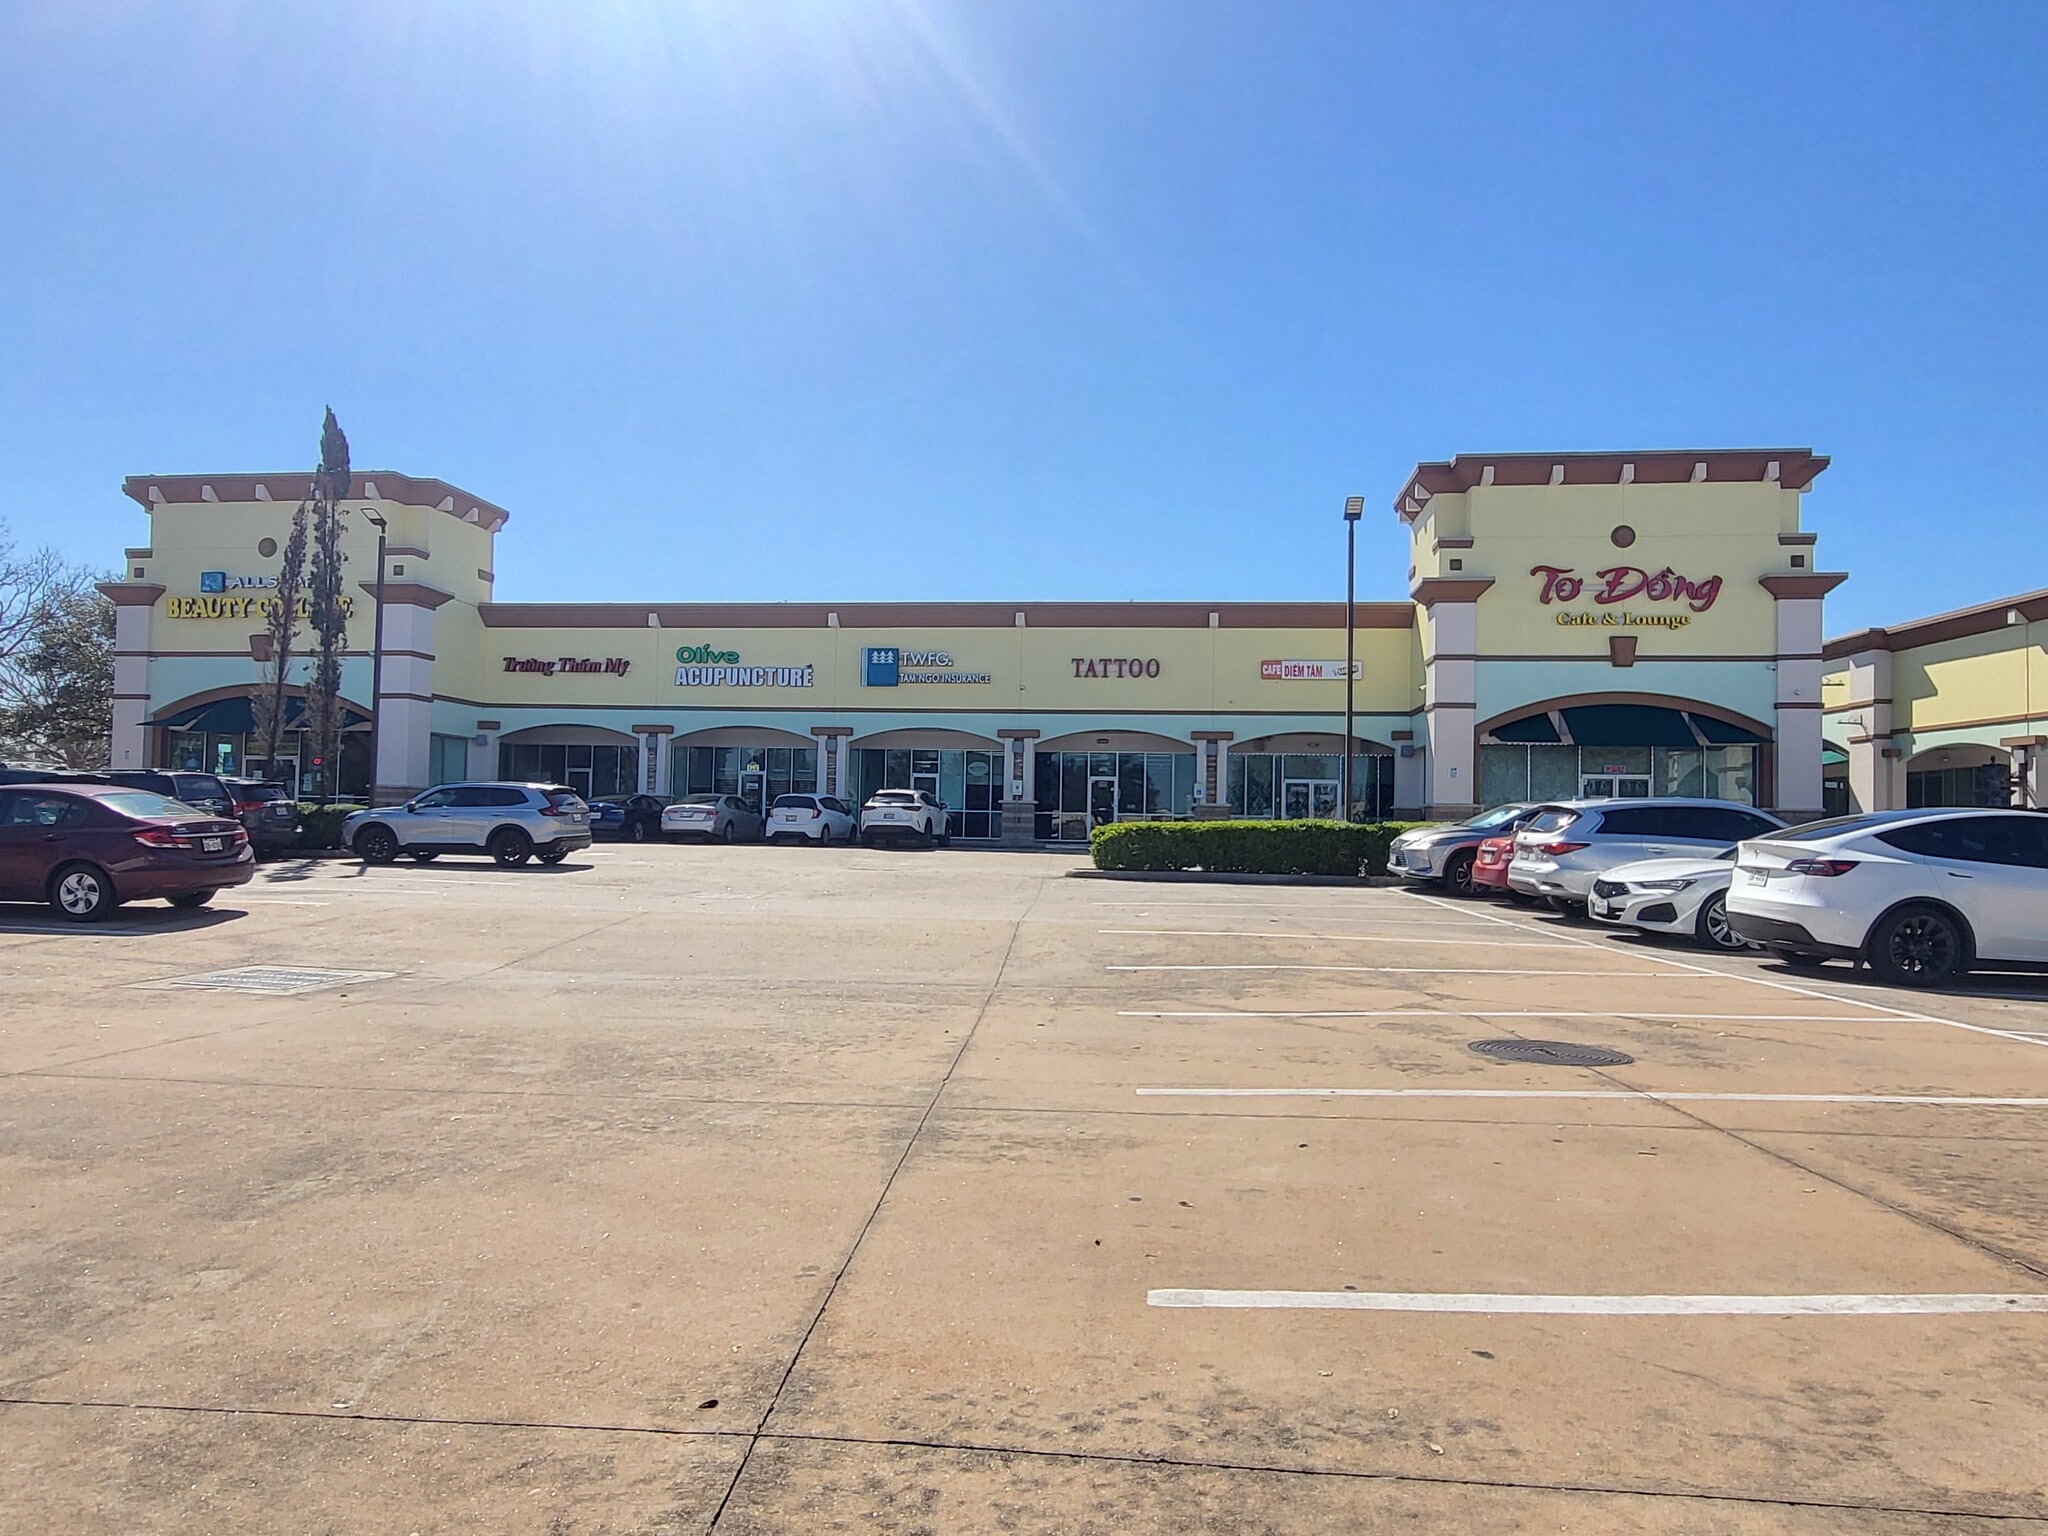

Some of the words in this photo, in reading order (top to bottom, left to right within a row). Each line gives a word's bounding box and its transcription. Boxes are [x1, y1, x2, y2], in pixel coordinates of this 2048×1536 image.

[167, 598, 252, 618] BEAUTY
[1556, 612, 1597, 626] Cafe
[1601, 613, 1618, 626] &
[1623, 612, 1691, 630] Lounge
[676, 644, 740, 664] Olive
[674, 666, 813, 687] ACUPUNCTURE
[1071, 658, 1160, 678] TATTOO
[1263, 664, 1281, 675] CAFE
[900, 673, 917, 684] TAM
[918, 673, 941, 684] NGO
[942, 673, 991, 684] INSURANCE
